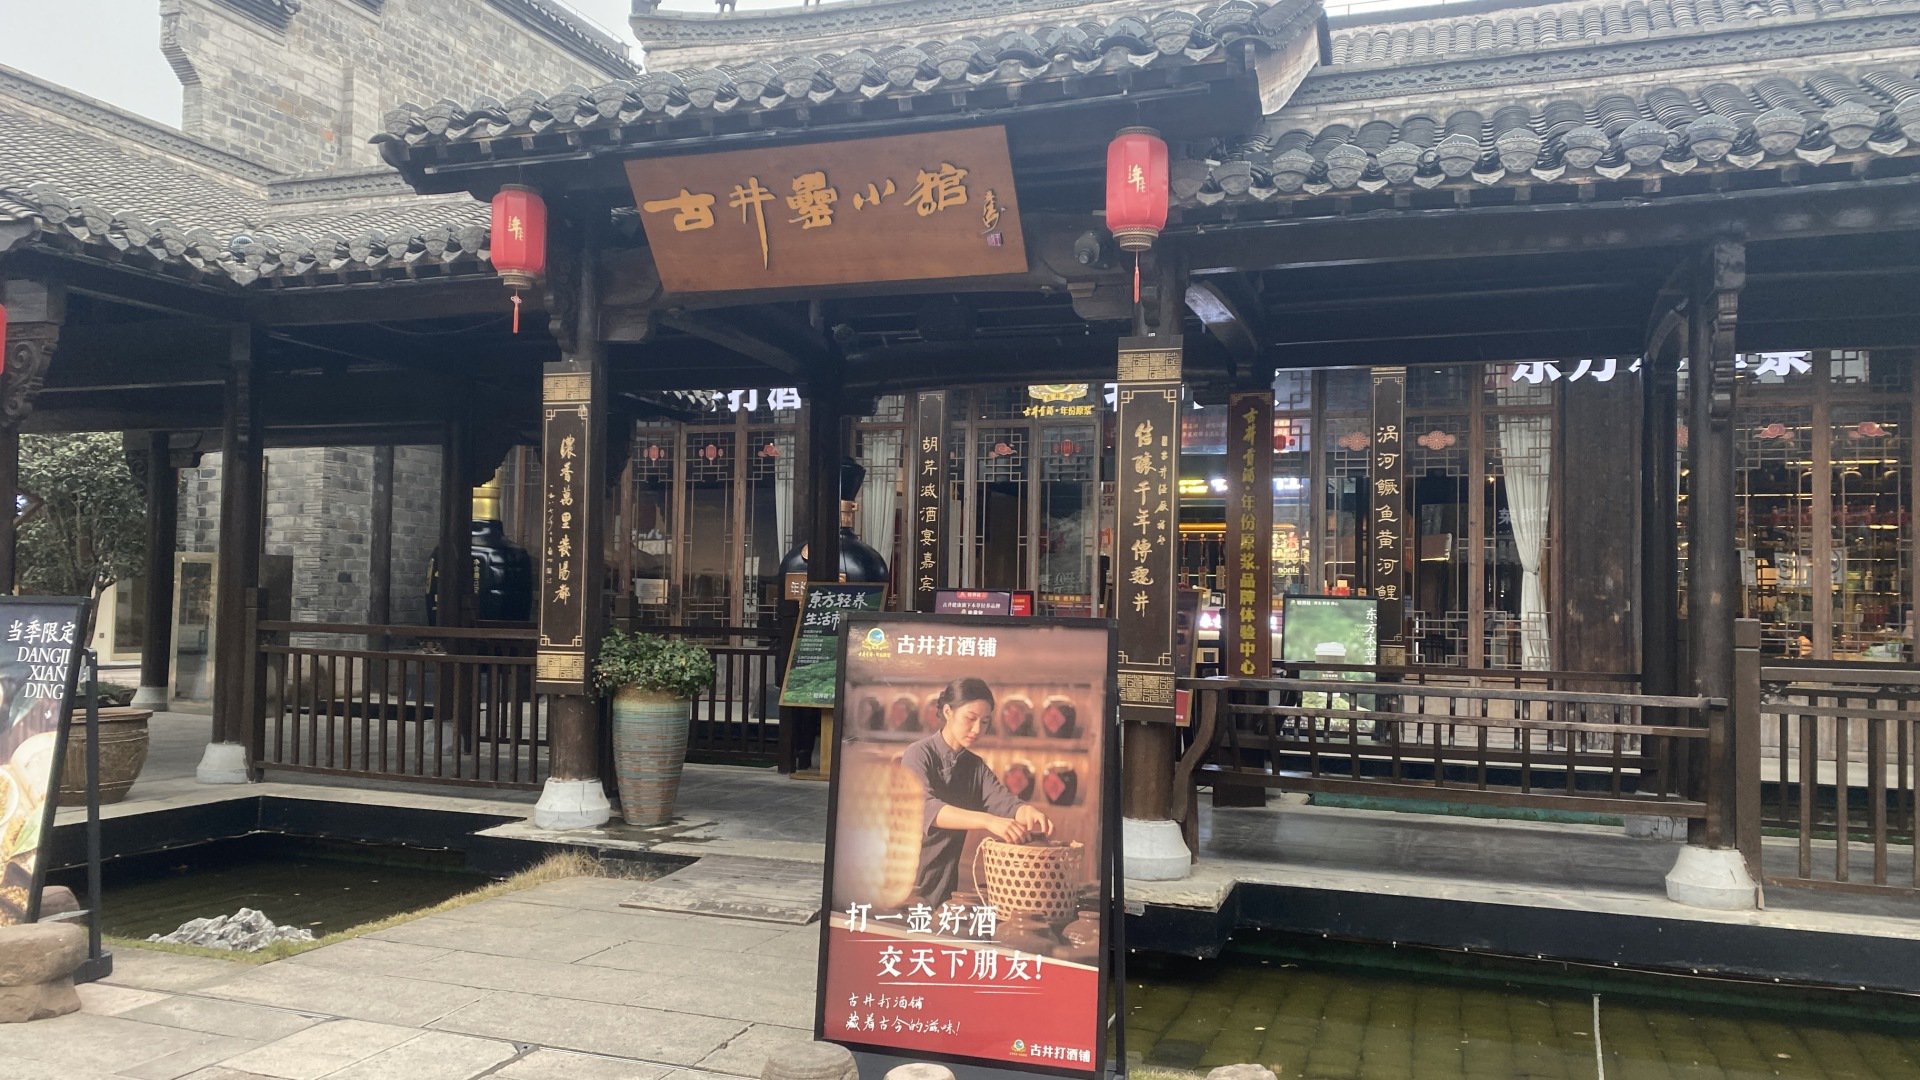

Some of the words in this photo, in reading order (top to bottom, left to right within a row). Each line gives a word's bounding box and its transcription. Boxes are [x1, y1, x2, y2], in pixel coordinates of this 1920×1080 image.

[7, 619, 76, 644] 当季限定
[16, 646, 71, 668] DANGJI
[897, 634, 998, 658] 古井打酒铺
[28, 665, 68, 682] XIAN
[24, 682, 65, 700] DING
[844, 901, 999, 937] 打一壶好酒
[876, 945, 1045, 981] 交天下朋友!
[848, 992, 925, 1010] 古井打酒铺
[1030, 1043, 1091, 1063] 古井打酒铺
